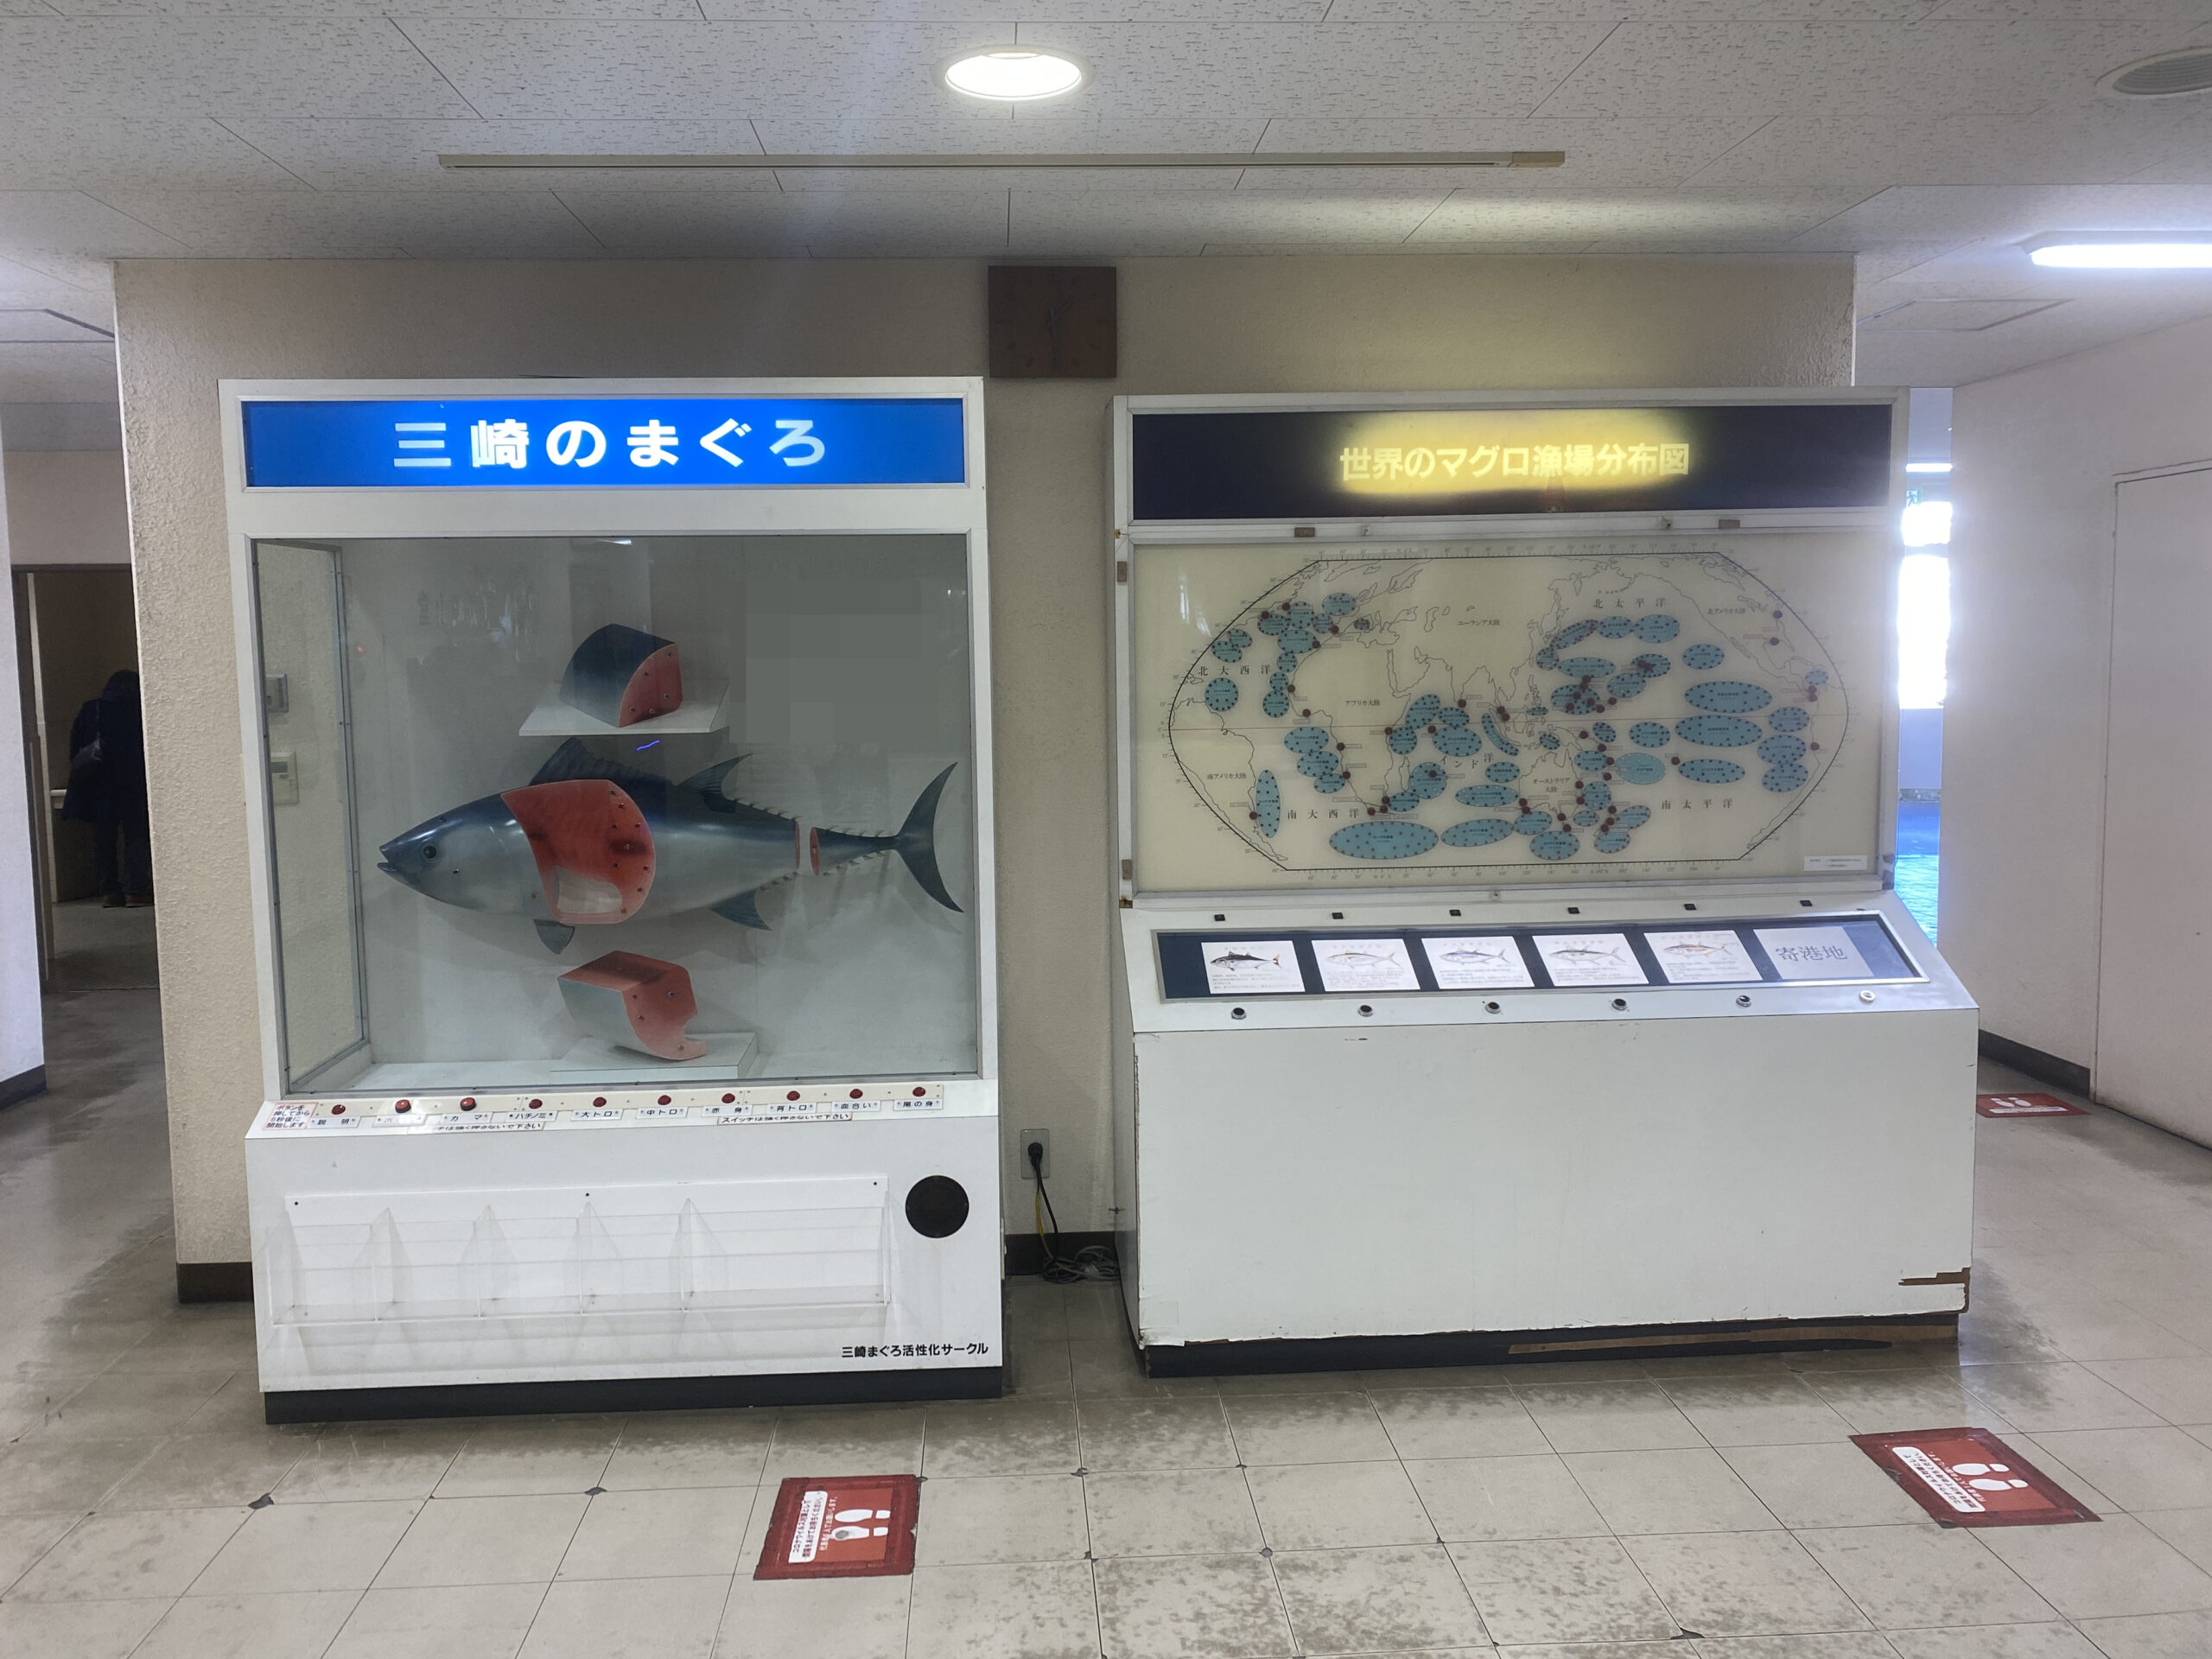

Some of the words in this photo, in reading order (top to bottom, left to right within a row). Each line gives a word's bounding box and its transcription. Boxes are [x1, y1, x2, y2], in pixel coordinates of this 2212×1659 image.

[393, 418, 827, 469] 三崎のまぐろ
[1339, 442, 1690, 481] 世界のマグロ漁場分布図
[1592, 596, 1668, 610] 北太平洋
[1197, 664, 1272, 677] 北大西洋
[1206, 772, 1247, 780] 南アメリカ大陸
[1532, 777, 1571, 785] オーストラリア
[1661, 798, 1733, 810] 南太平洋
[1287, 808, 1360, 820] 南大西洋
[1775, 945, 1848, 962] 寄港地
[841, 1342, 989, 1358] 三崎まぐろ活性化サークル
